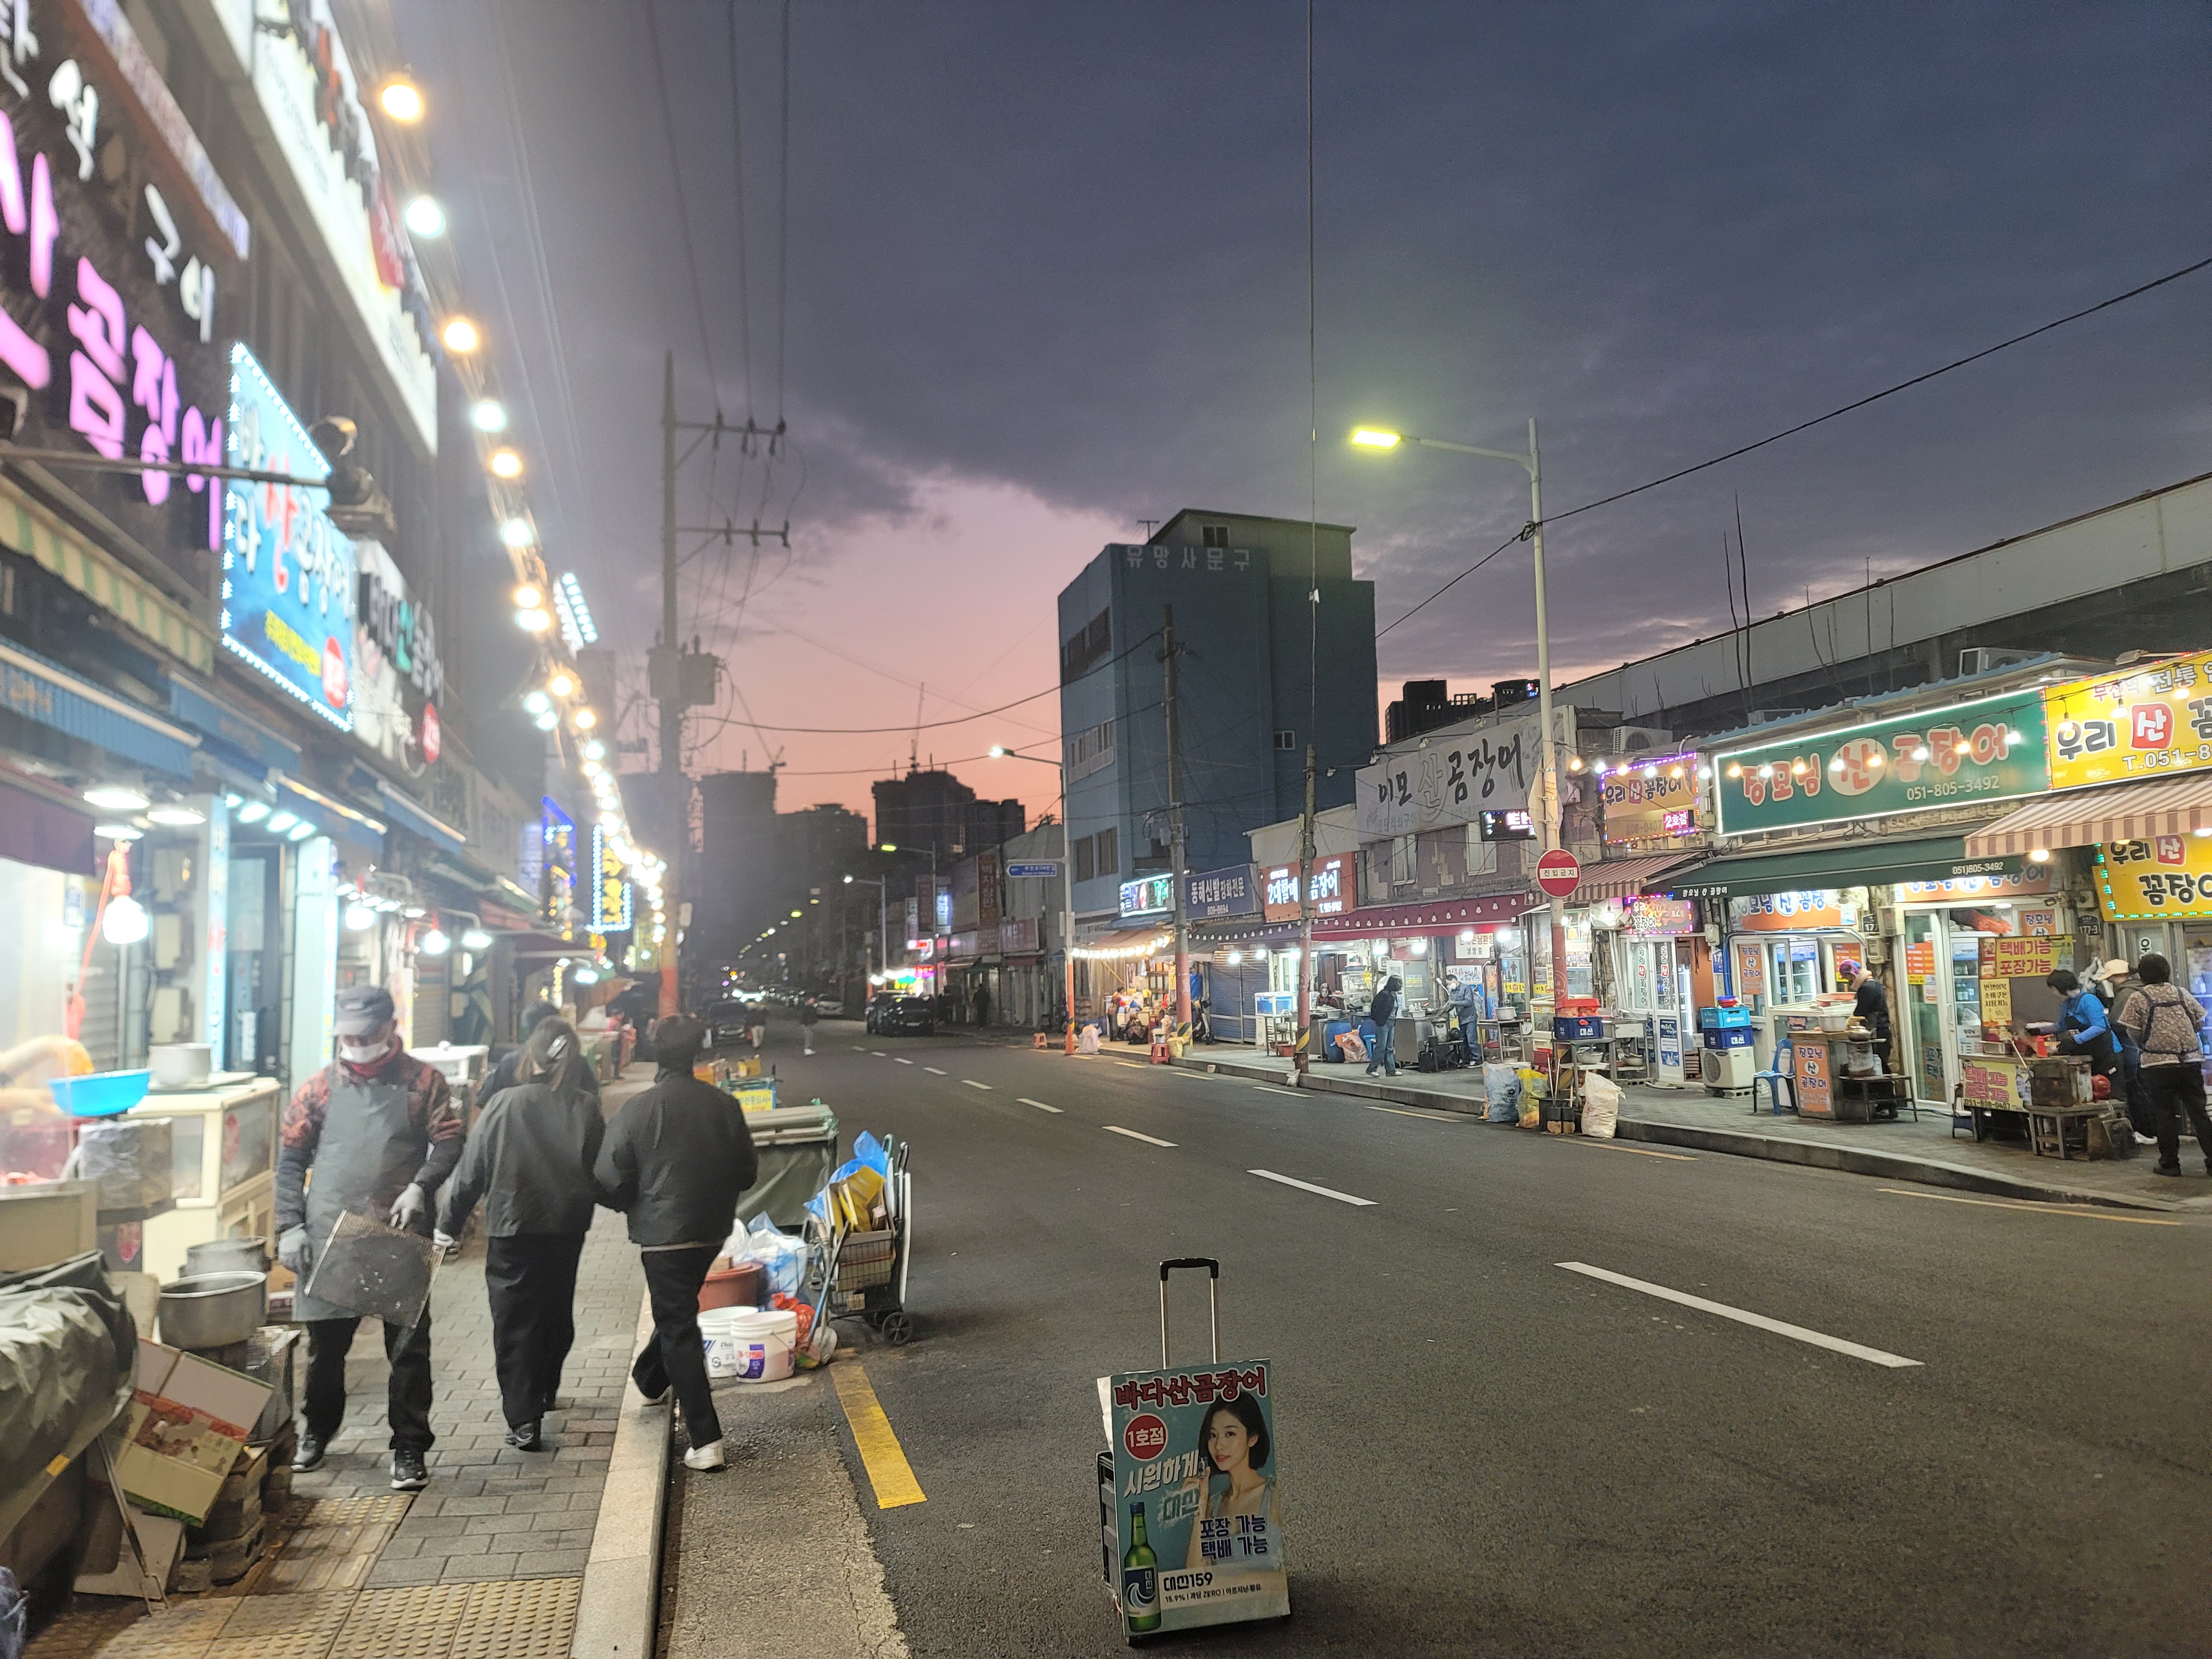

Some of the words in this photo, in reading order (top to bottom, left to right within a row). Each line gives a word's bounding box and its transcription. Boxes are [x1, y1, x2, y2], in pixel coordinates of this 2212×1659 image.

[2152, 664, 2197, 694] 전통
[2057, 721, 2116, 760] 우리
[2137, 708, 2168, 742] 산
[1379, 771, 1412, 806] 이모
[1419, 753, 1443, 808] 산
[1447, 733, 1525, 805] 곰장어
[1742, 752, 1821, 806] 장모님
[1841, 743, 1871, 790] 산
[1605, 785, 1626, 806] 우리
[1906, 775, 2000, 801] 051-805-3492
[1665, 811, 1688, 828] 2호점
[2110, 841, 2152, 865] 우리
[2160, 838, 2181, 860] 산
[1543, 869, 1575, 877] 진입금지
[1952, 861, 2004, 875] 051)805-3492
[1191, 878, 1220, 905] 동해신발
[1220, 877, 1245, 900] 장화전문
[1267, 876, 1299, 905] 2대할매
[1780, 891, 1793, 913] 산
[2079, 925, 2098, 934] 177-3
[2000, 940, 2052, 956] 택배가능
[2000, 958, 2052, 975] 포장가능
[1731, 1036, 1745, 1044] 대선
[1965, 1067, 1988, 1084] 택배
[1989, 1071, 2008, 1087] 가능
[1965, 1082, 1990, 1100] 포장
[1990, 1087, 2010, 1103] 가능
[1114, 1365, 1266, 1411] 바다산곰장어
[1127, 1427, 1164, 1448] 1호점
[1124, 1449, 1199, 1499] 시원하게
[1200, 1517, 1230, 1540] 포장
[1235, 1514, 1266, 1533] 가능
[1201, 1538, 1232, 1561] 택배
[1237, 1535, 1268, 1556] 가능
[1165, 1594, 1186, 1603] 15.9%
